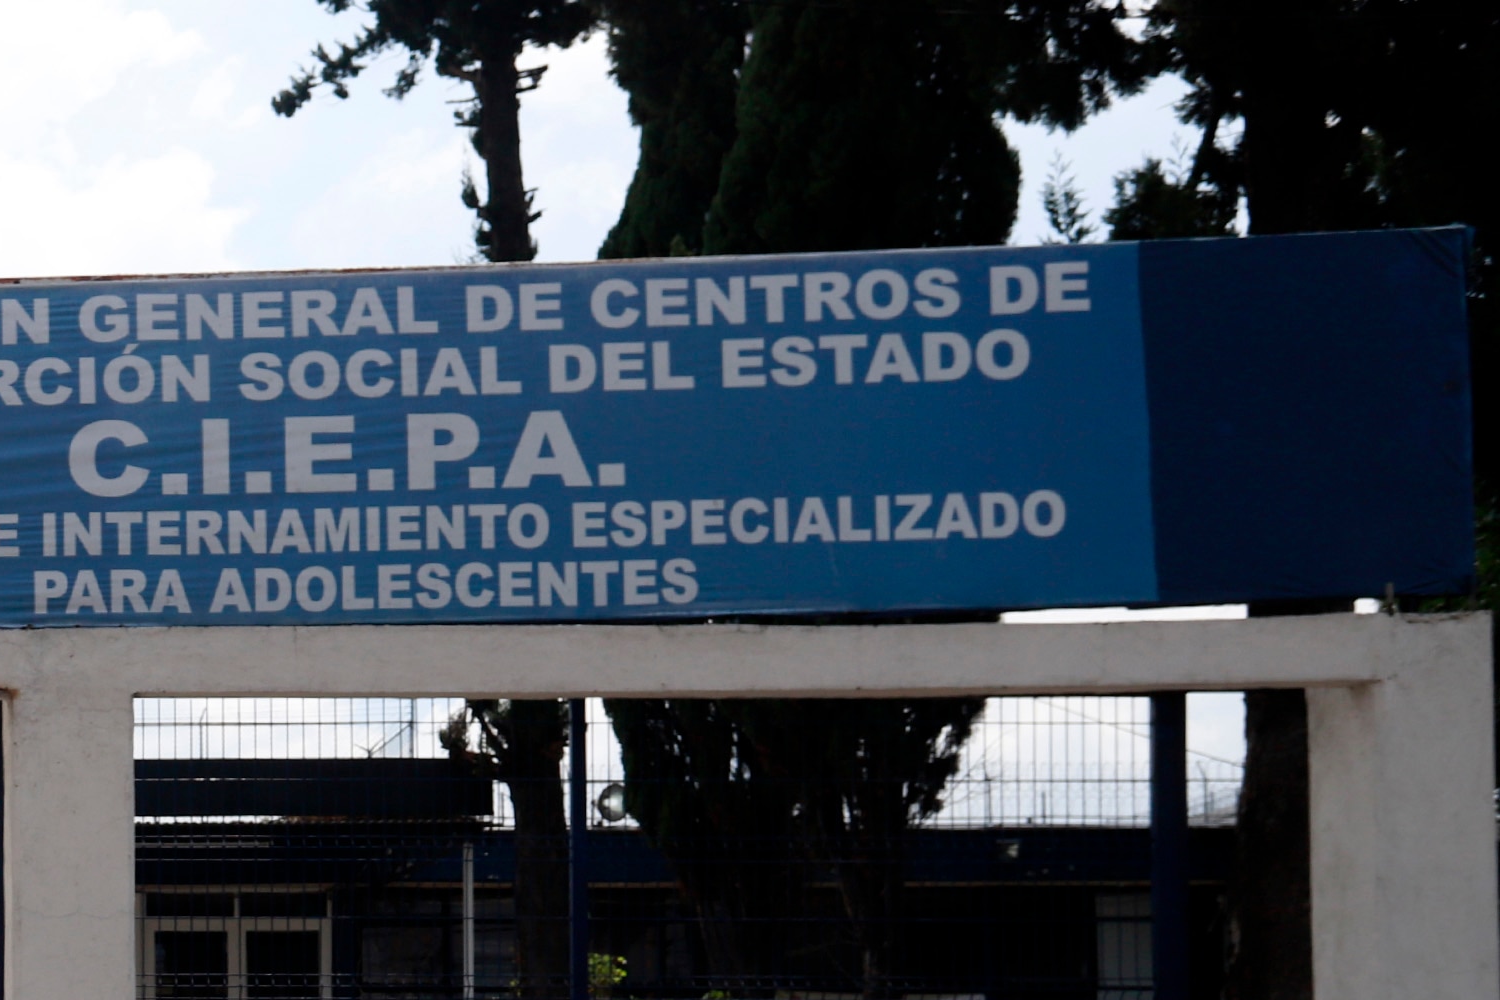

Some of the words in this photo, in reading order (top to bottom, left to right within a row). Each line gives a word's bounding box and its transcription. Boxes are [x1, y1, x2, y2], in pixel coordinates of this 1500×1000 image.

[78, 286, 439, 344] GENERAL
[465, 282, 564, 333] DE
[589, 267, 962, 328] CENTROS
[989, 261, 1091, 316] DE
[238, 347, 522, 402] SOCIAL
[548, 340, 695, 394] DEL
[721, 327, 1031, 389] ESTADO
[68, 409, 627, 499] C.I.E.P.A.
[42, 506, 551, 557] INTERNAMIENTO
[572, 489, 1067, 549] ESPECIALIZADO
[33, 569, 192, 615] PARA
[209, 556, 700, 615] ADOLESCENTES
